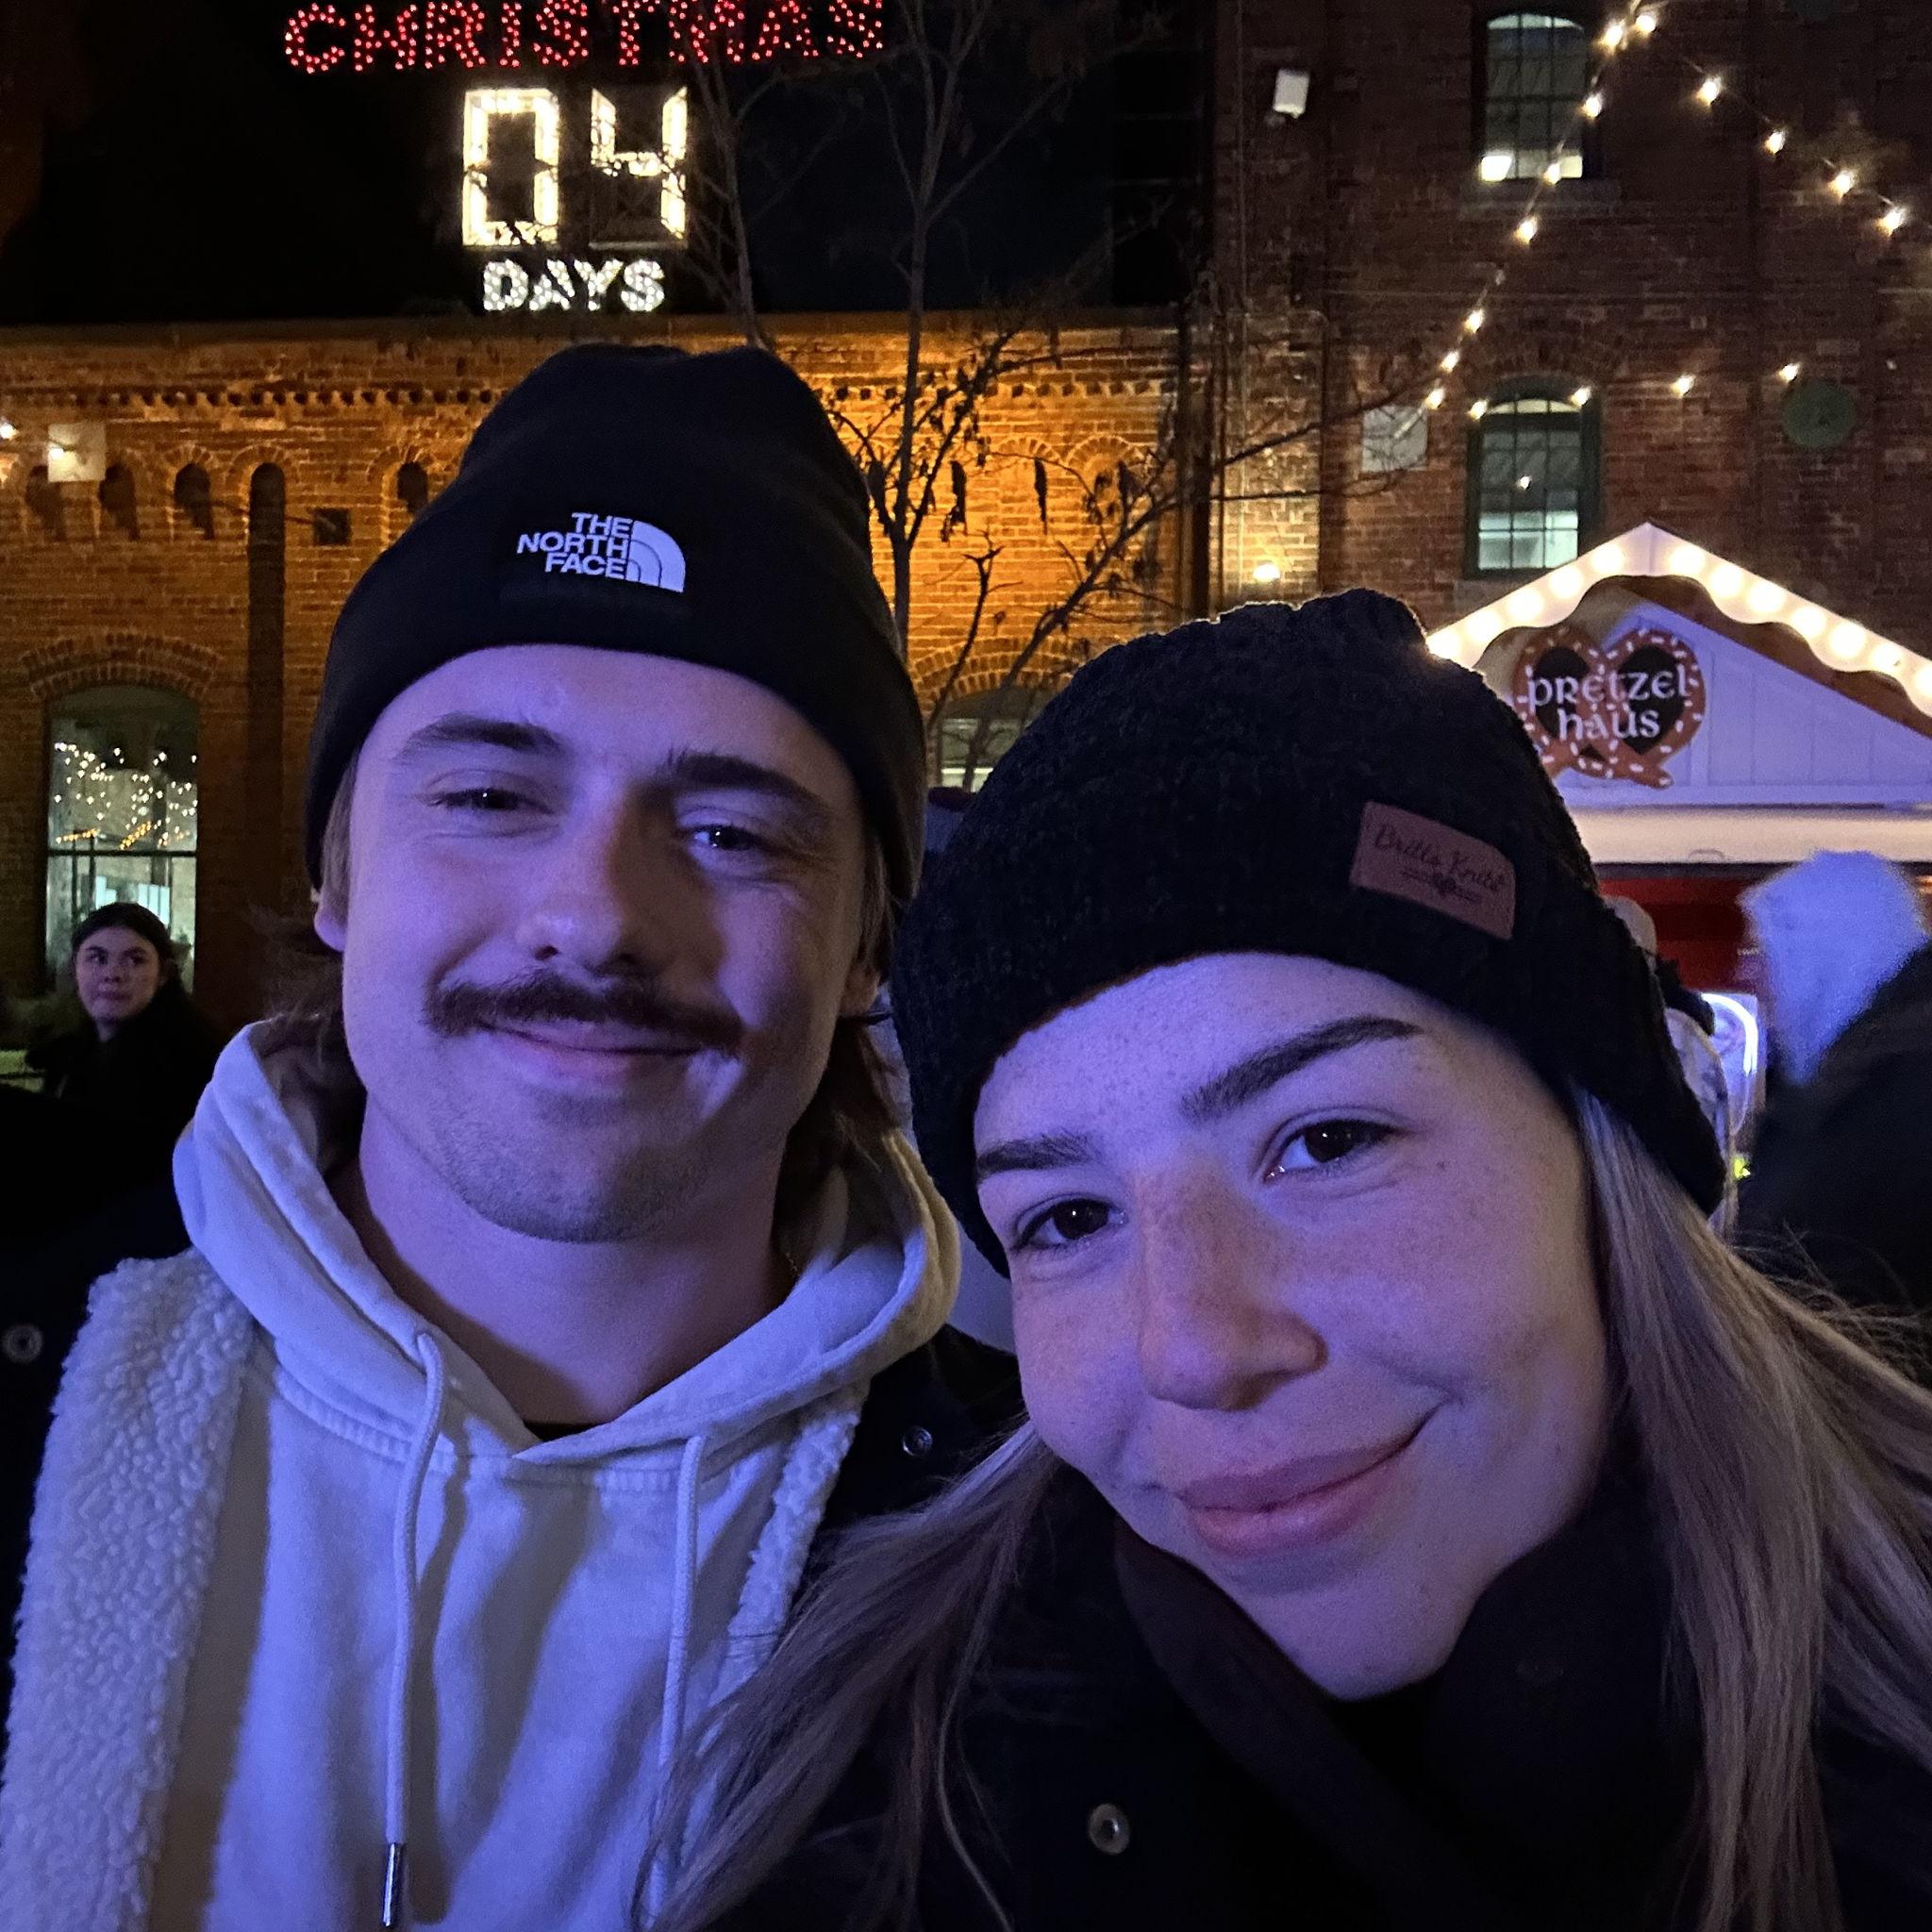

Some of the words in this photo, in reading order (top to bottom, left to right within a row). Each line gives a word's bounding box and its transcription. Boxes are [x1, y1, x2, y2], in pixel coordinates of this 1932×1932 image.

[284, 0, 885, 74] CHRISTMAS
[462, 87, 688, 246] 04
[482, 258, 665, 311] DAYS
[516, 530, 630, 560] NORTH
[571, 511, 634, 539] THE
[544, 551, 626, 581] FACE
[1526, 662, 1691, 714] pretzel
[1557, 708, 1661, 741] haus
